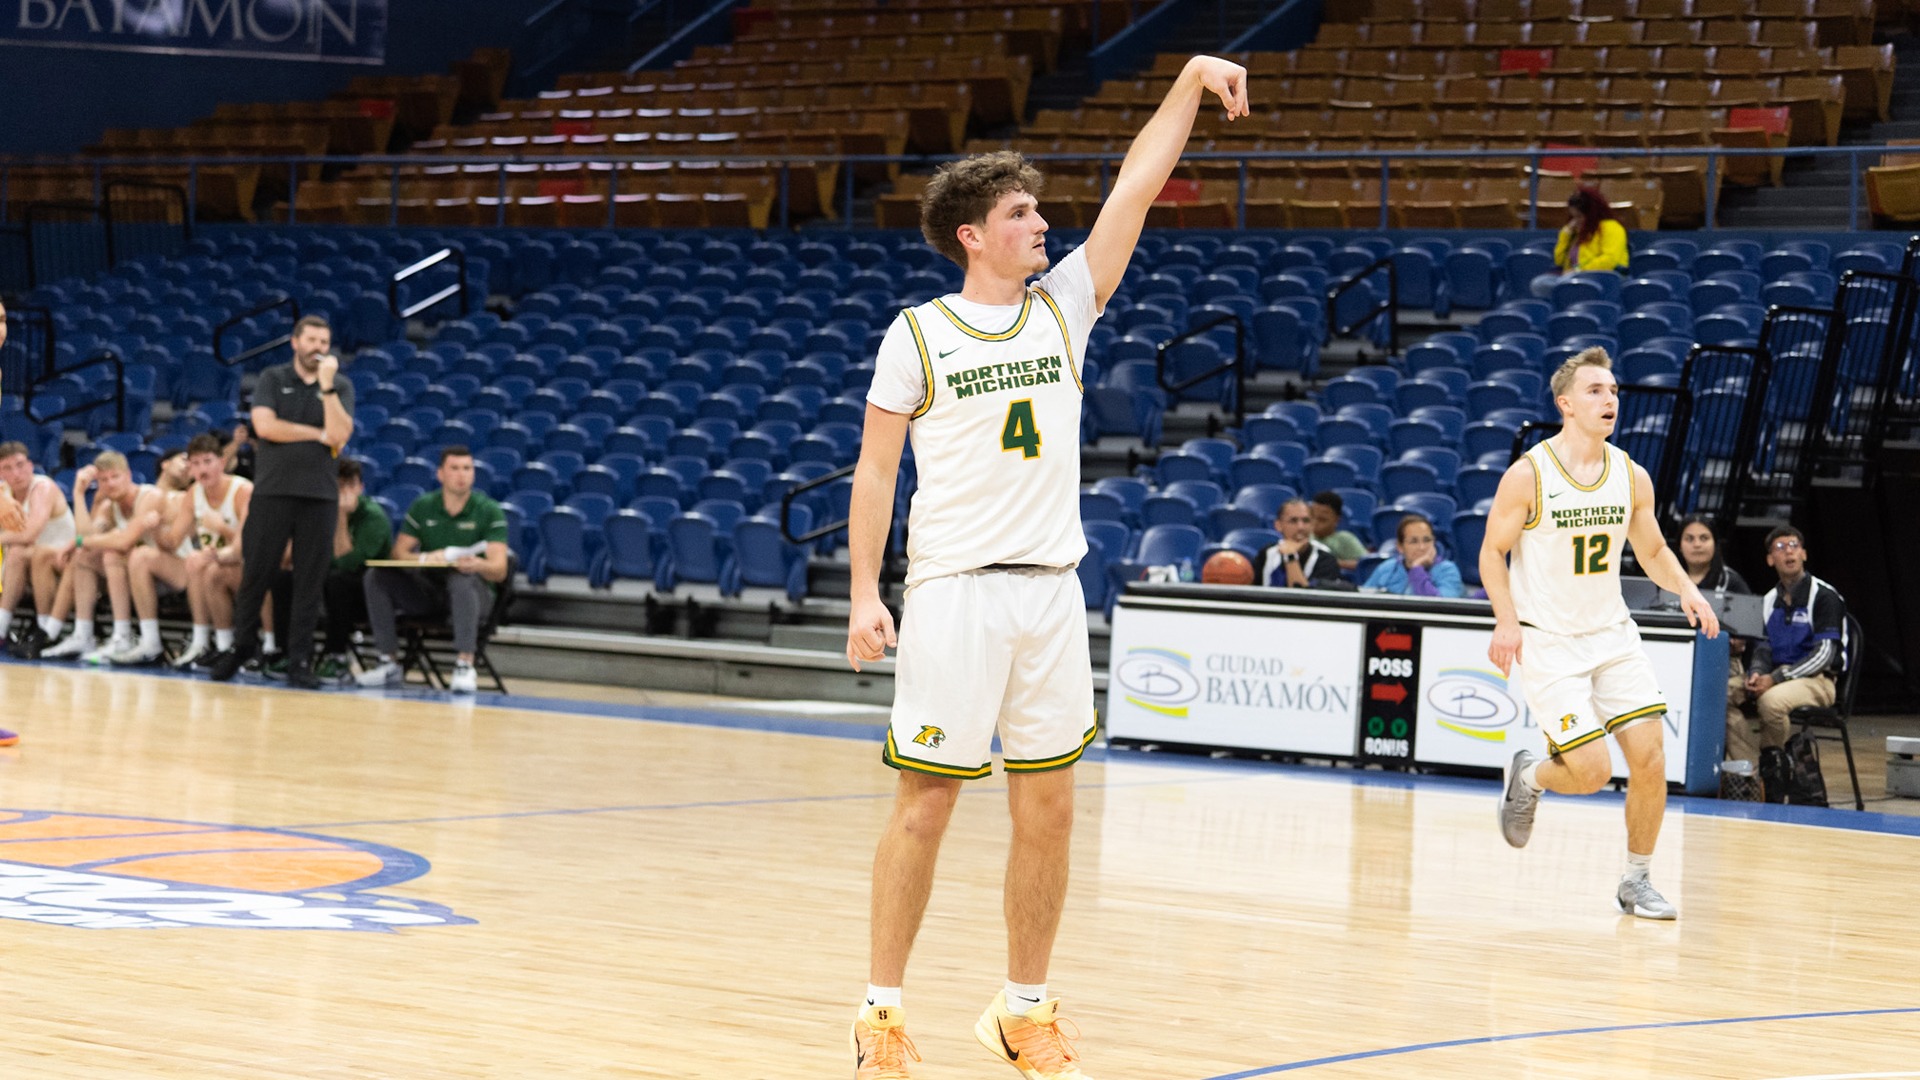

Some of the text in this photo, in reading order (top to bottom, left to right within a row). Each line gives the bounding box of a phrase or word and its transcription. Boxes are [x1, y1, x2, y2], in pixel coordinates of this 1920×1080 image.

[946, 355, 1062, 388] NORTHERN
[954, 370, 1061, 400] MICHIGAN
[1000, 398, 1042, 461] 4
[1551, 505, 1626, 519] NORTHERN
[1556, 515, 1624, 529] MICHIGAN
[1572, 532, 1612, 576] 12
[1206, 653, 1284, 677] CIUDAD
[1368, 656, 1414, 679] POSS
[1205, 675, 1352, 714] BAYAMÓN
[1363, 736, 1410, 758] BONUS
